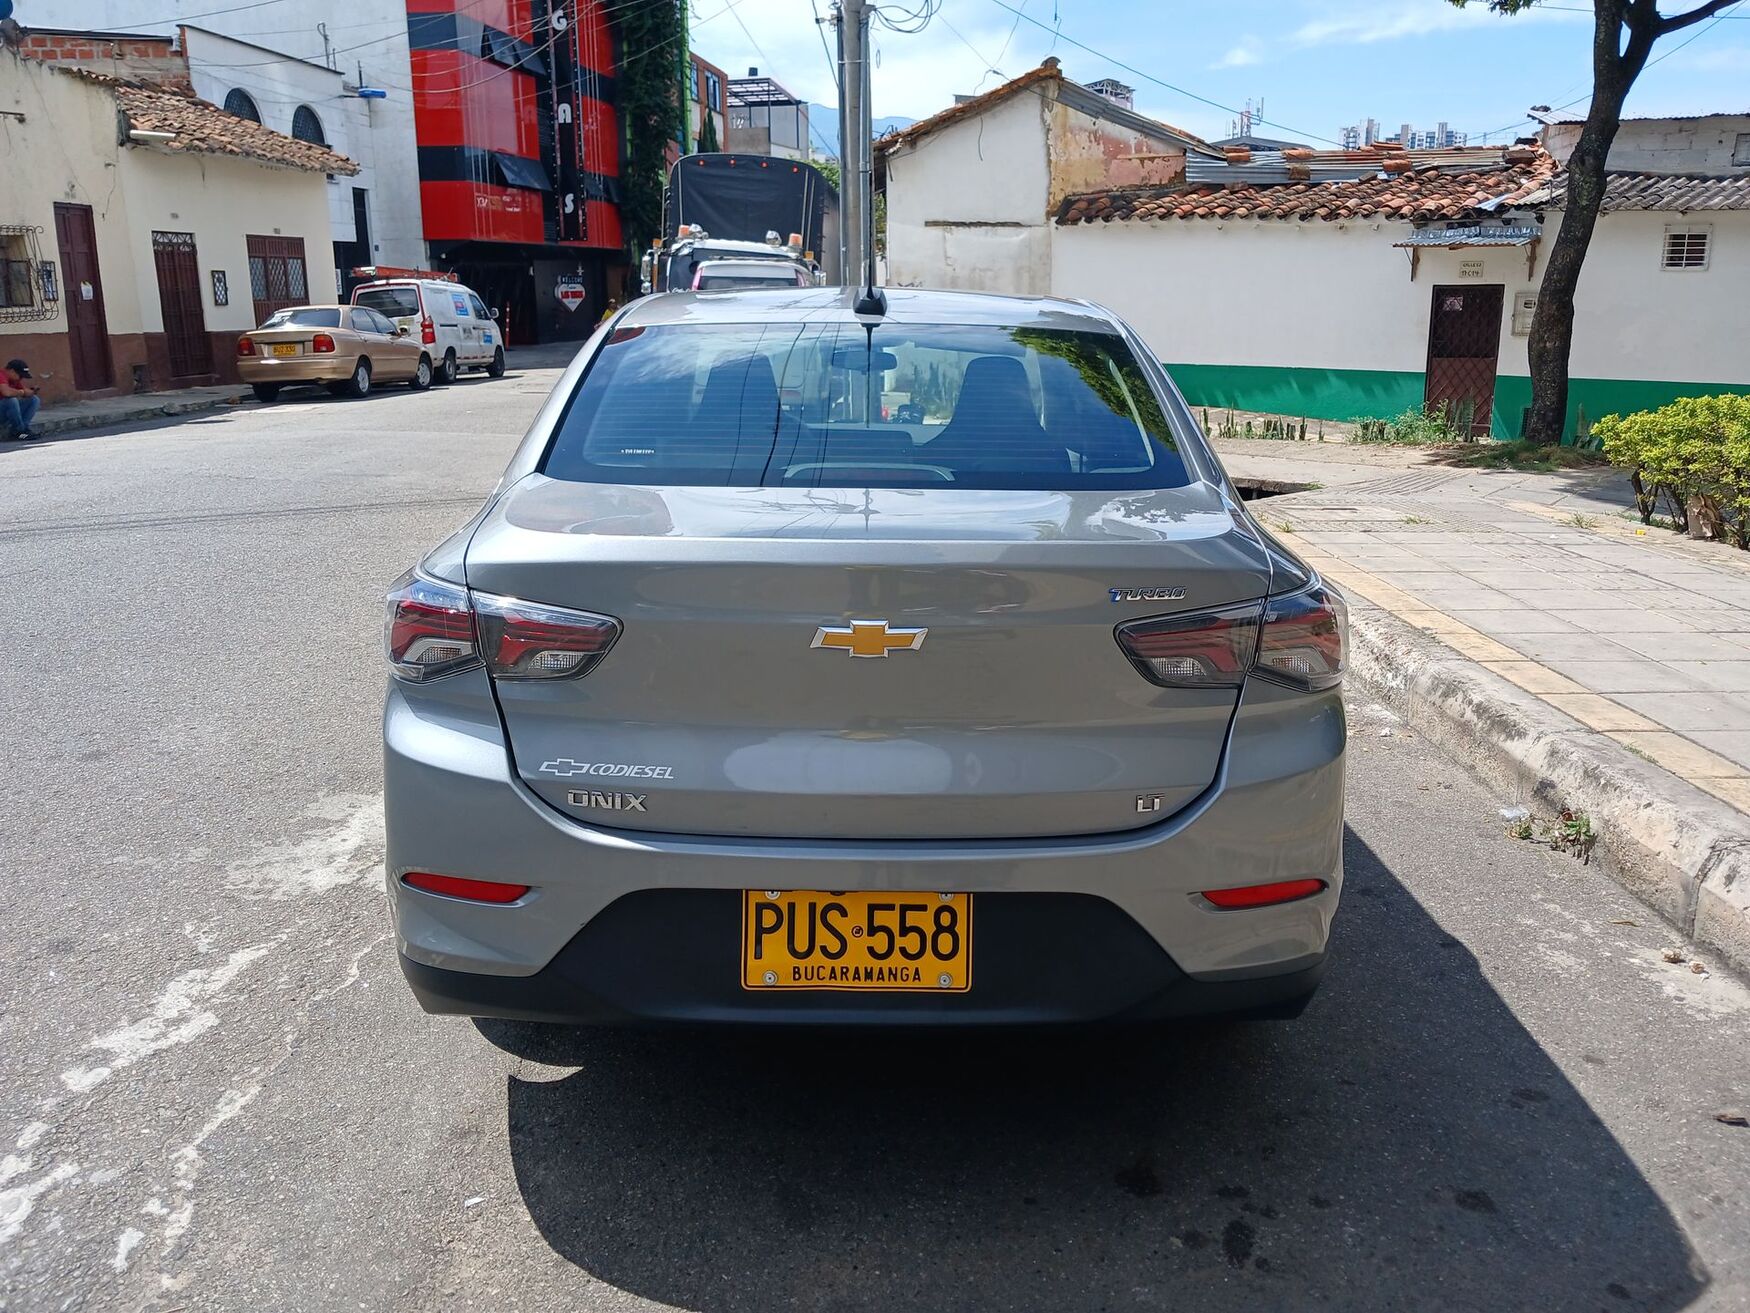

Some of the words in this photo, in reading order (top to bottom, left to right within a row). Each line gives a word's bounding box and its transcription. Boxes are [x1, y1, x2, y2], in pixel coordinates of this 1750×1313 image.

[1108, 586, 1187, 602] TURBO
[588, 762, 675, 780] CODIESEL
[566, 789, 648, 813] ONIX
[1135, 793, 1166, 813] LT
[753, 901, 849, 960] PUS
[866, 903, 961, 962] 558
[792, 965, 922, 983] BUCARAMANGA
